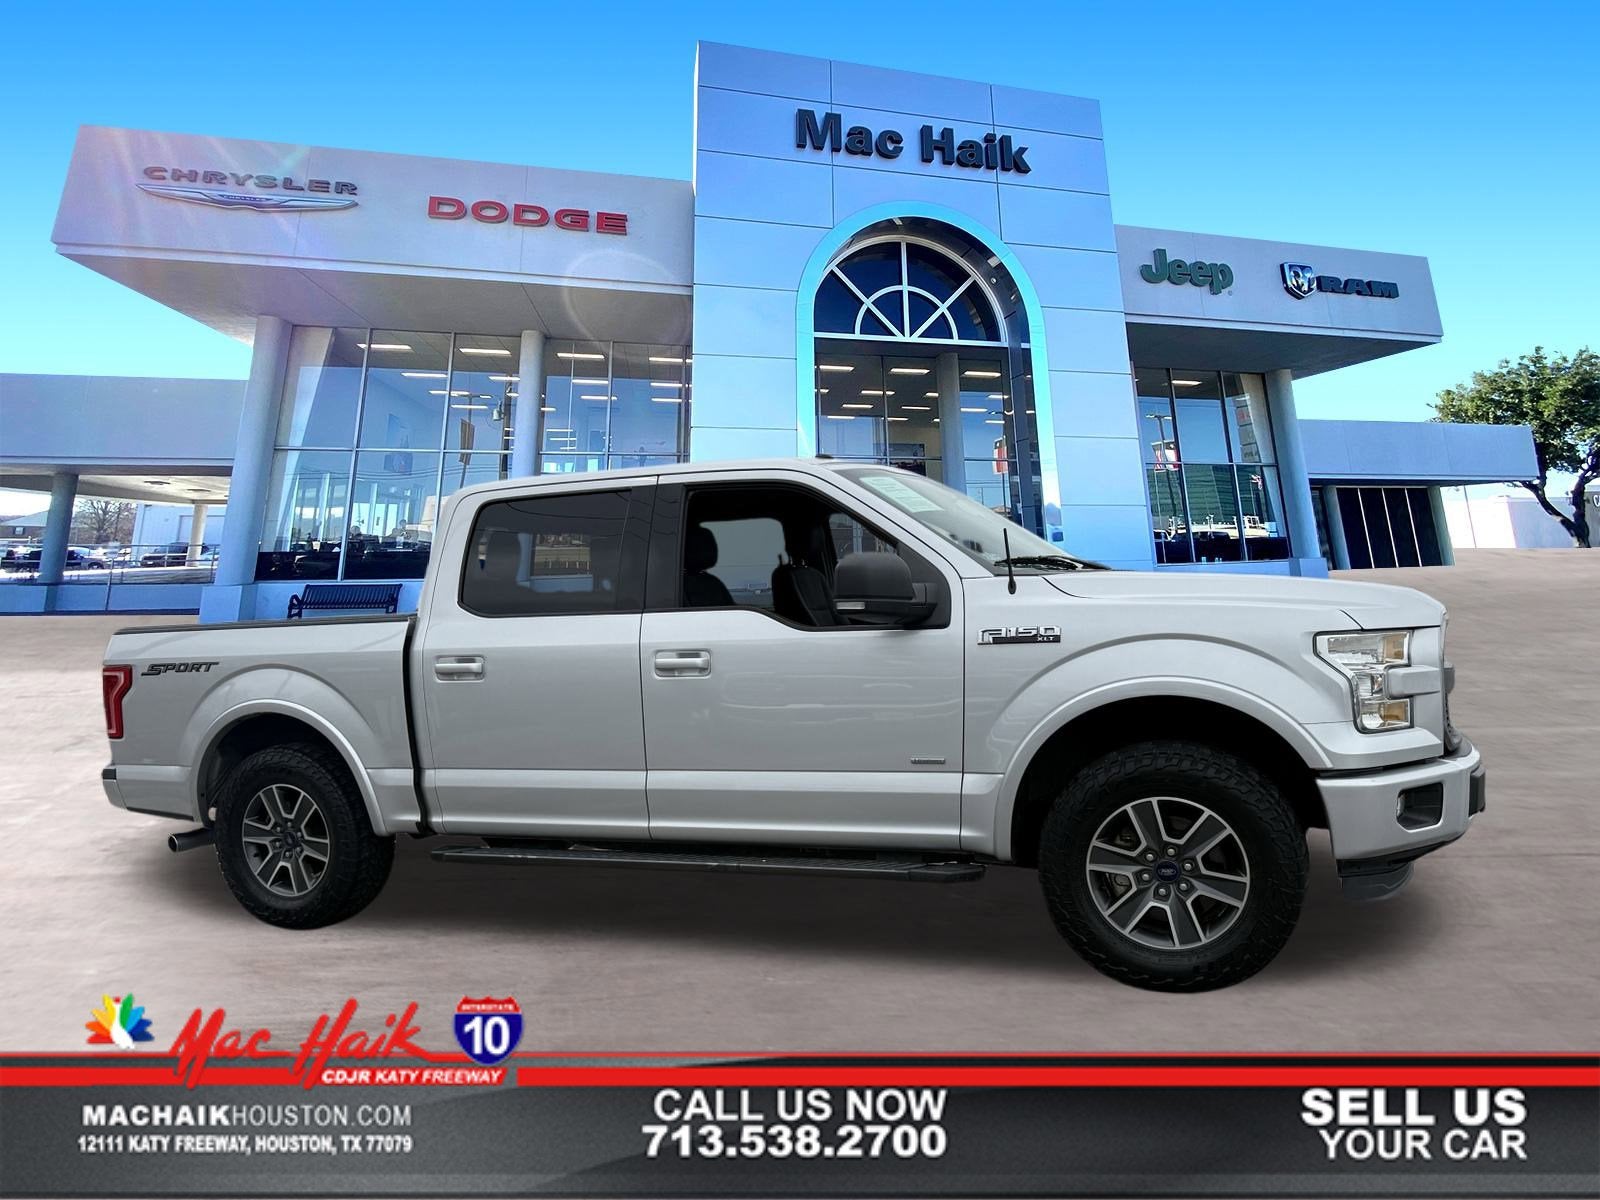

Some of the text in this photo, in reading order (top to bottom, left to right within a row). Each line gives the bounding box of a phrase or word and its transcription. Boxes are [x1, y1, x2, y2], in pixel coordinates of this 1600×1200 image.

[796, 108, 1032, 175] Mac Haik
[142, 166, 359, 196] CHRYSLER
[428, 195, 628, 235] DODGE
[1140, 248, 1234, 296] Jeep
[1316, 275, 1399, 299] RAM
[141, 662, 220, 676] SPORT
